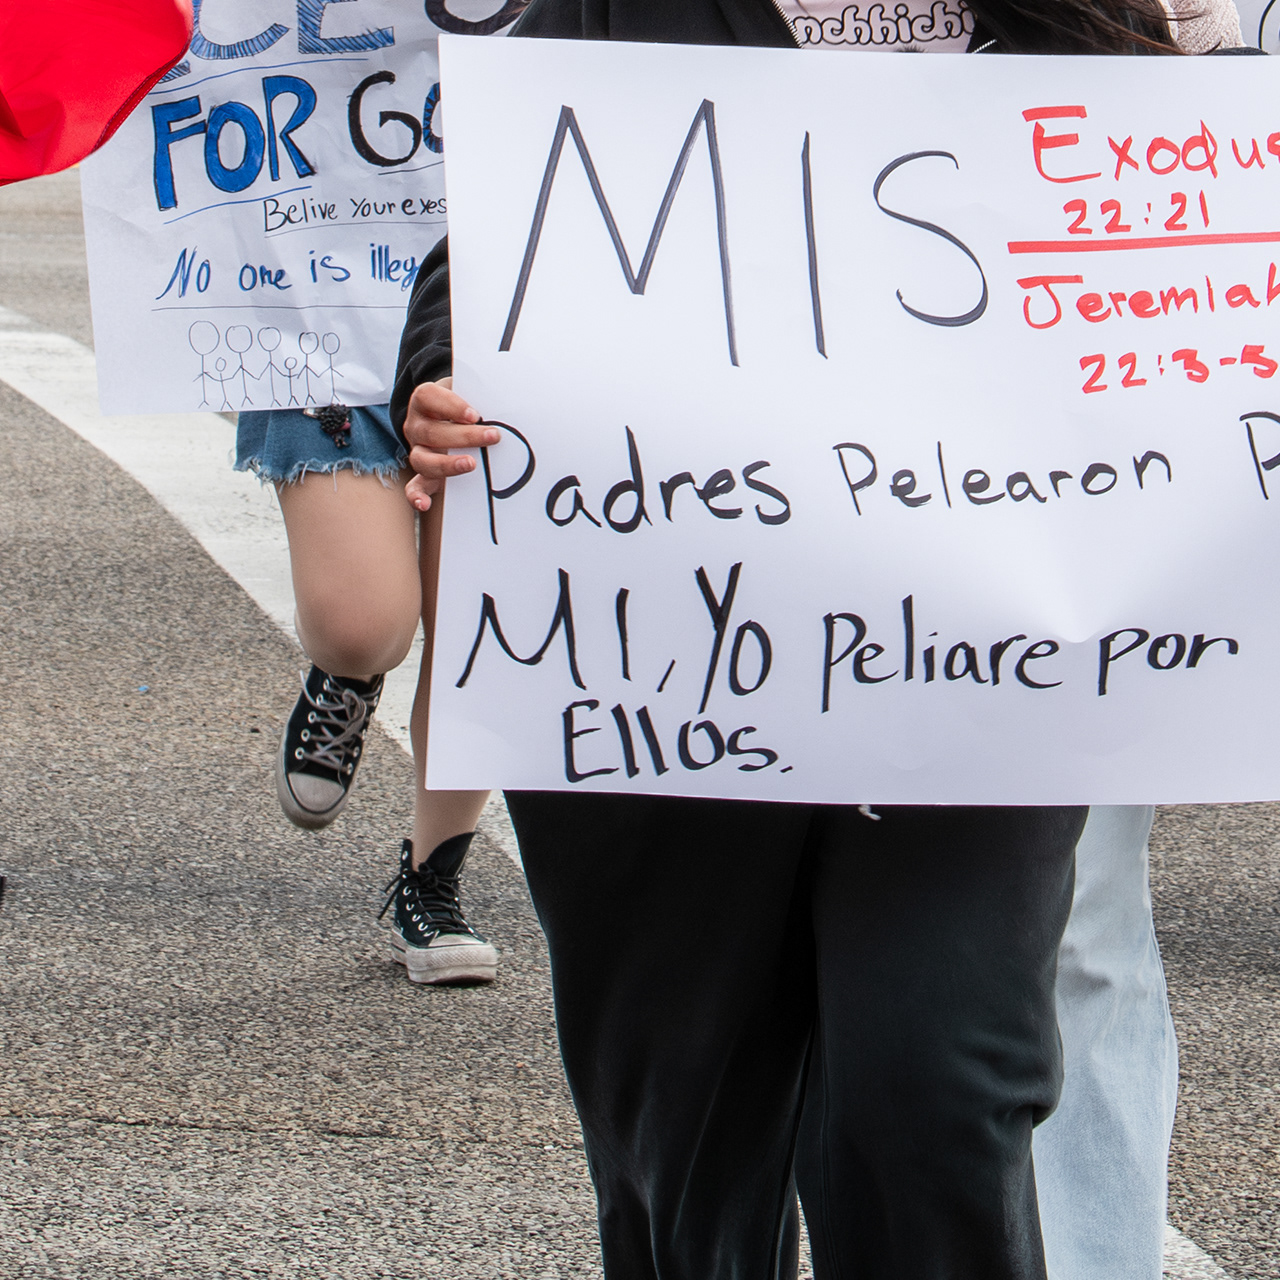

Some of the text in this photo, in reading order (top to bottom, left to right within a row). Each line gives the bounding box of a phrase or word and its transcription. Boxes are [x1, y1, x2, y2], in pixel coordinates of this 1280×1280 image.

[151, 74, 317, 212] FOR
[263, 196, 339, 234] Belive
[499, 97, 988, 367] MIS
[1063, 190, 1210, 234] 22:21
[156, 246, 211, 300] No
[239, 261, 292, 291] one
[309, 250, 351, 285] is
[478, 418, 792, 545] Padres
[832, 440, 1173, 517] Pelearon
[694, 561, 772, 714] Yo
[562, 698, 794, 783] Ellos.
